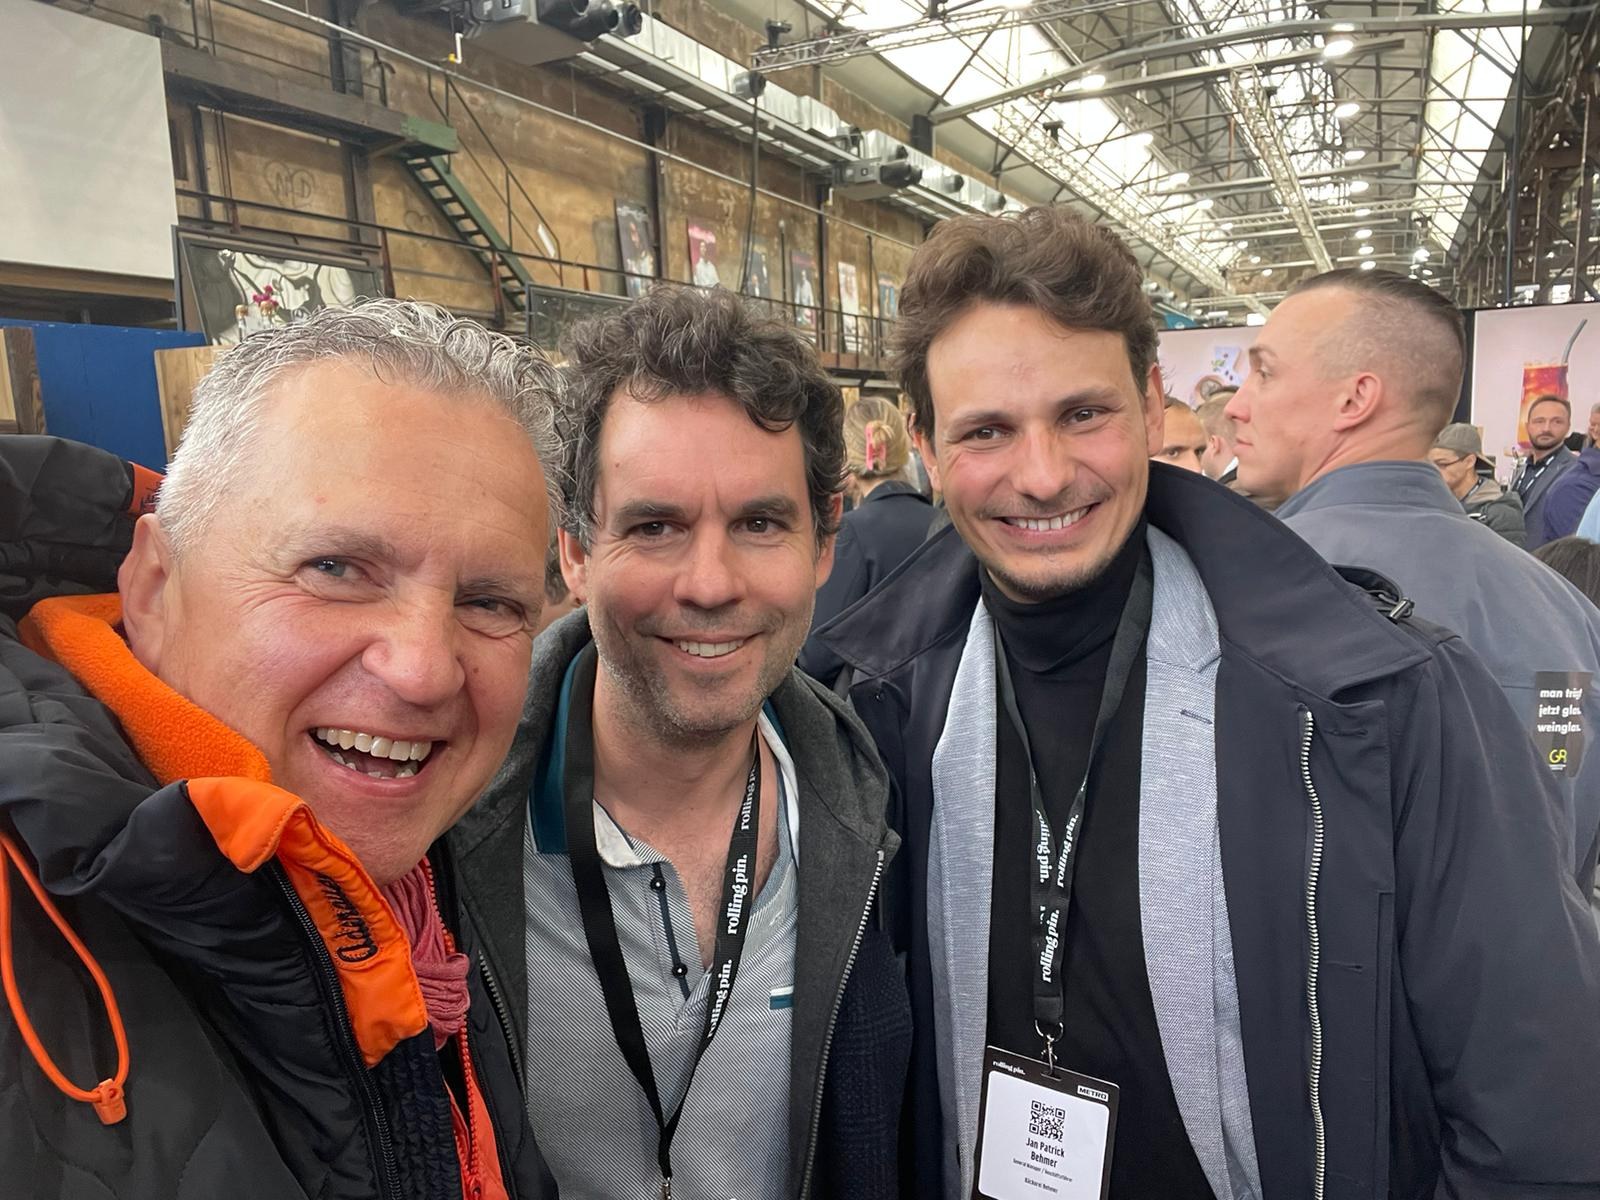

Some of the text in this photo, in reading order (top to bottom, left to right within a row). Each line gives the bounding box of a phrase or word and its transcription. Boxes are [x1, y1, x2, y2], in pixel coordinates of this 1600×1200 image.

[1540, 689, 1563, 698] man
[1538, 704, 1560, 718] jetzt
[1057, 840, 1072, 888] rolling
[726, 854, 749, 934] rolling pin.
[1046, 909, 1060, 939] pin.
[1040, 935, 1059, 983] rolling
[718, 959, 733, 989] pin.
[1079, 1086, 1107, 1100] METRO
[1026, 1137, 1065, 1158] Jan Patrick
[1030, 1151, 1058, 1168] Behmer
